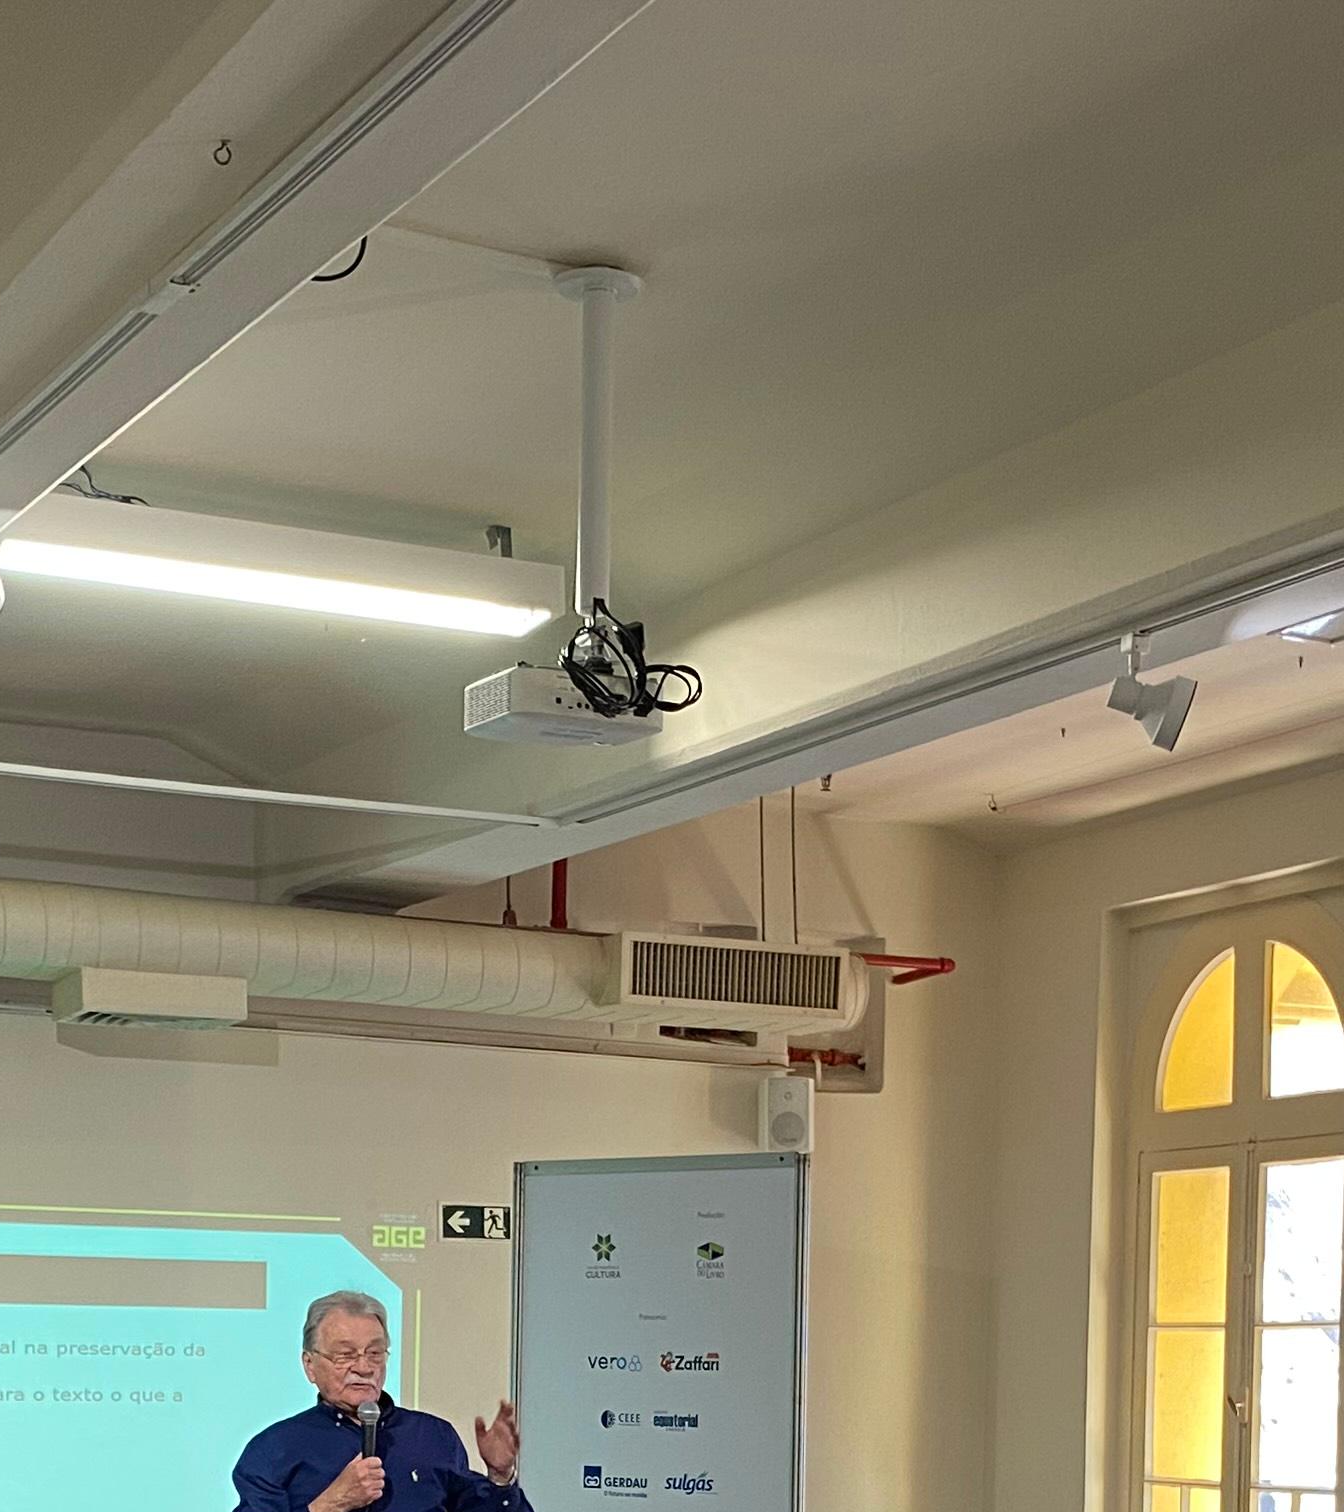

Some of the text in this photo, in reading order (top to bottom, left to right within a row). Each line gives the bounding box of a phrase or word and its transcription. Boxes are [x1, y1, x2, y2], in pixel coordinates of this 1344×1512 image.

[585, 1271, 621, 1280] CULTURA
[24, 1343, 48, 1355] na
[56, 1342, 176, 1359] preservação
[183, 1343, 206, 1358] da
[588, 1356, 626, 1369] vero
[675, 1355, 719, 1371] Zaffari
[33, 1390, 45, 1402] o
[53, 1388, 103, 1402] texto
[110, 1390, 123, 1402] o
[129, 1390, 165, 1406] que
[172, 1391, 183, 1402] a
[618, 1413, 640, 1423] CEEE
[604, 1477, 648, 1489] GERDAU
